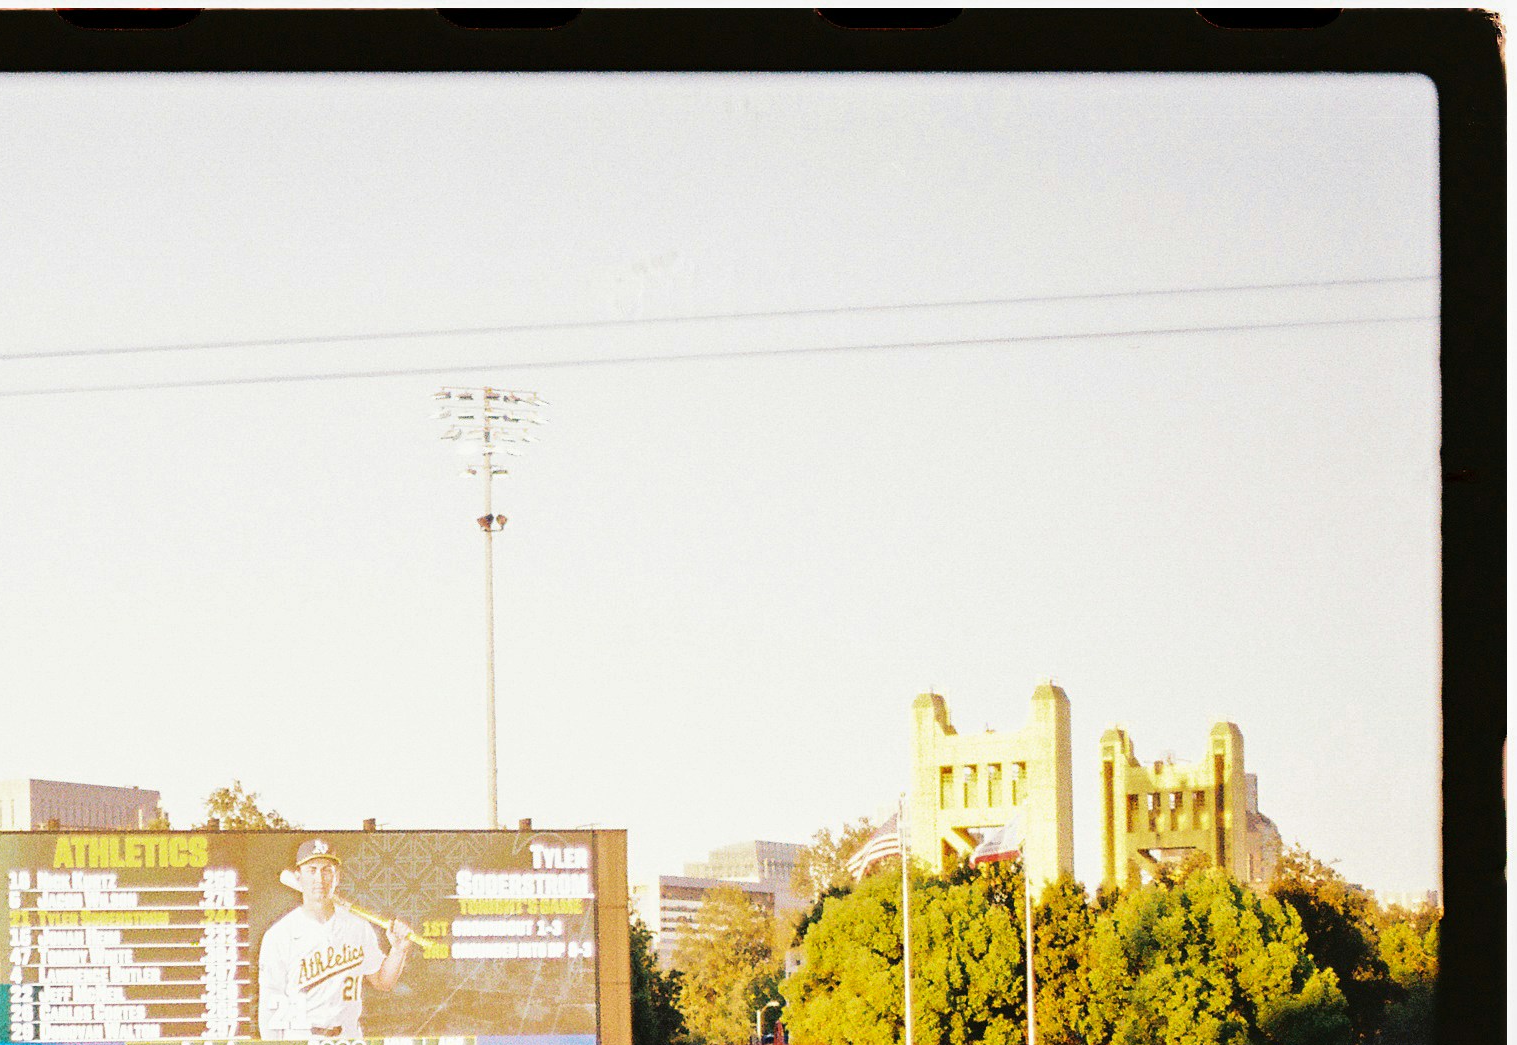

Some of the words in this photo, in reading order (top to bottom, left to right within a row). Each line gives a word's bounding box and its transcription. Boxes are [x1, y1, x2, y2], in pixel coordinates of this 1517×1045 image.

[53, 836, 209, 868] ATHLETICS
[423, 921, 449, 937] 1ST
[298, 944, 364, 984] Athletics
[343, 976, 359, 1001] 21
